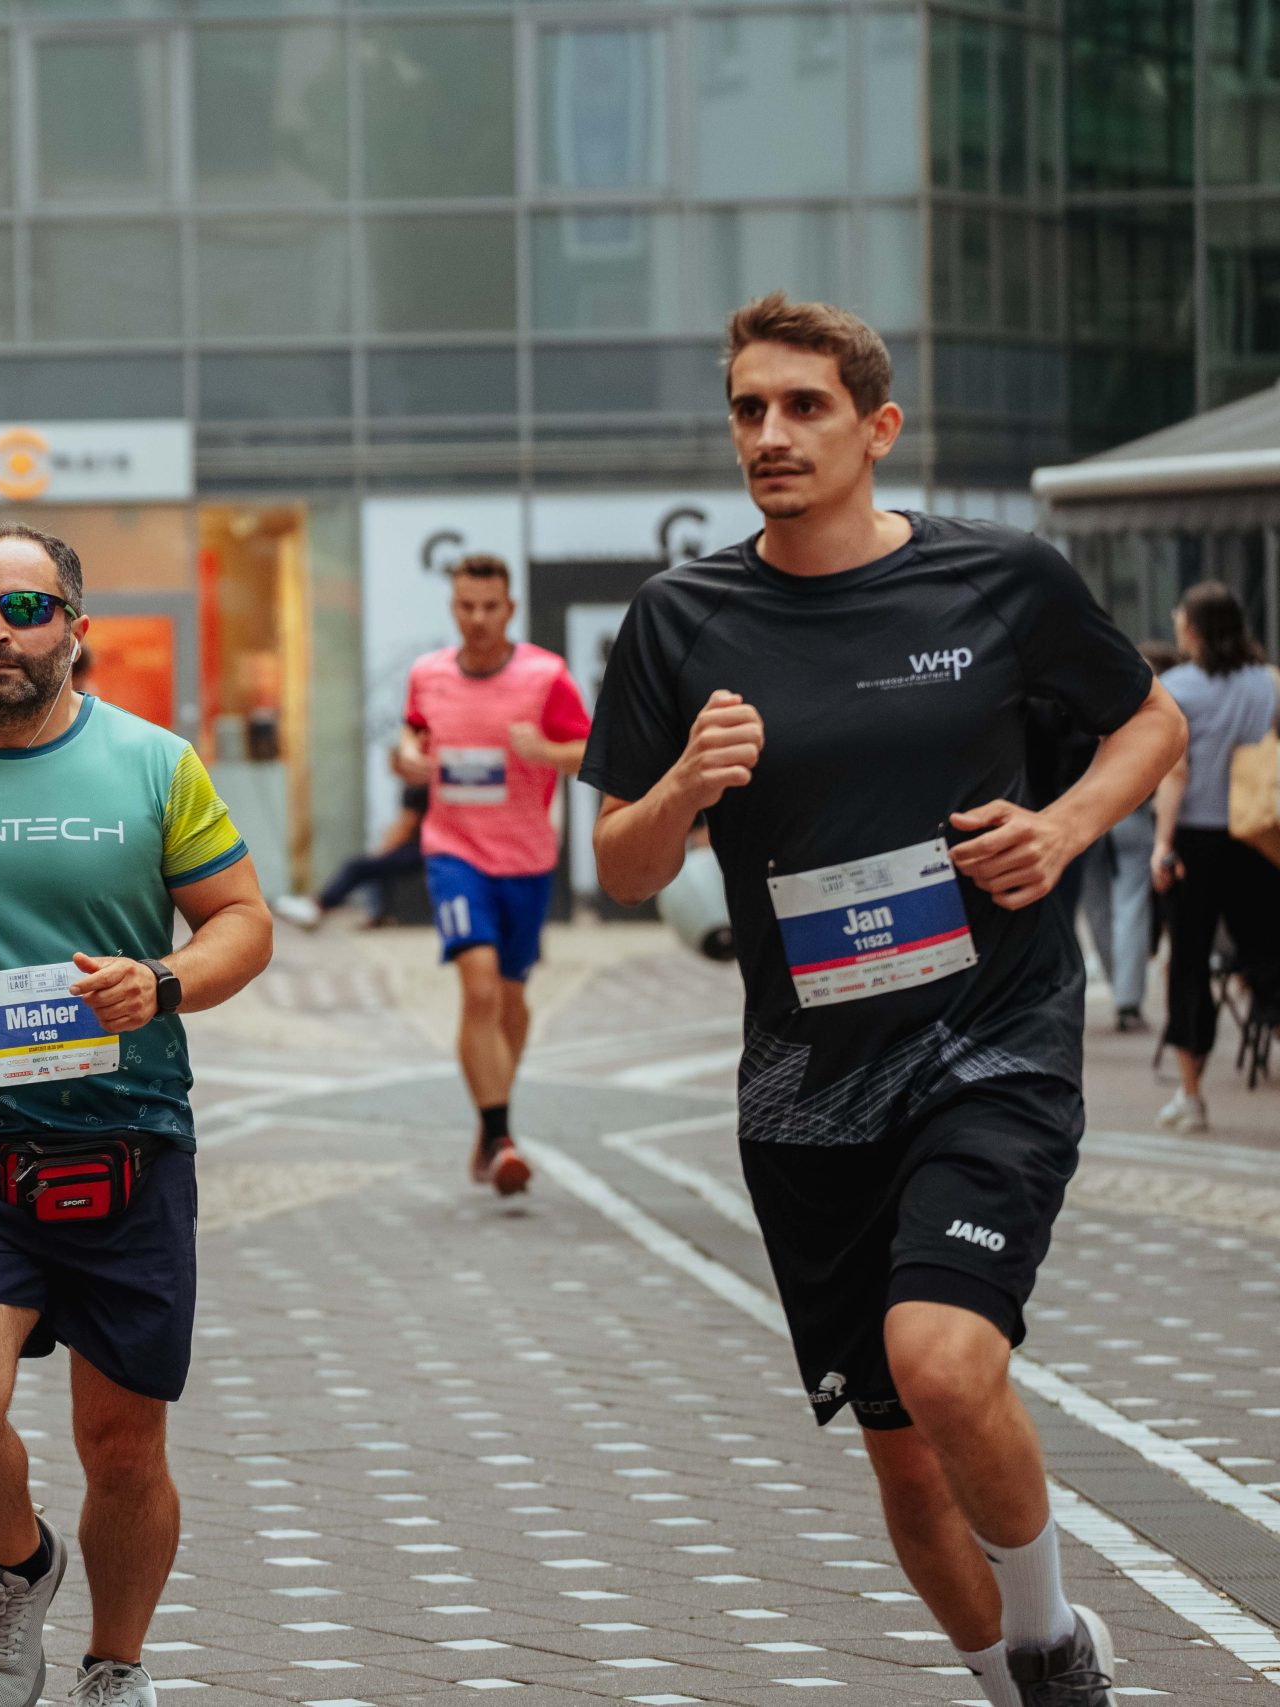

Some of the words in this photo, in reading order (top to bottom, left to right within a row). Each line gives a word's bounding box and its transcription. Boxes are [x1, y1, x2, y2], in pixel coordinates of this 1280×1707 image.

[842, 905, 894, 936] Jan
[854, 931, 893, 951] 11523
[10, 980, 29, 990] LAUF
[5, 1003, 79, 1031] Maher
[32, 1029, 58, 1042] 1436
[62, 1199, 86, 1207] SPORT
[945, 1219, 1006, 1252] JAKO
